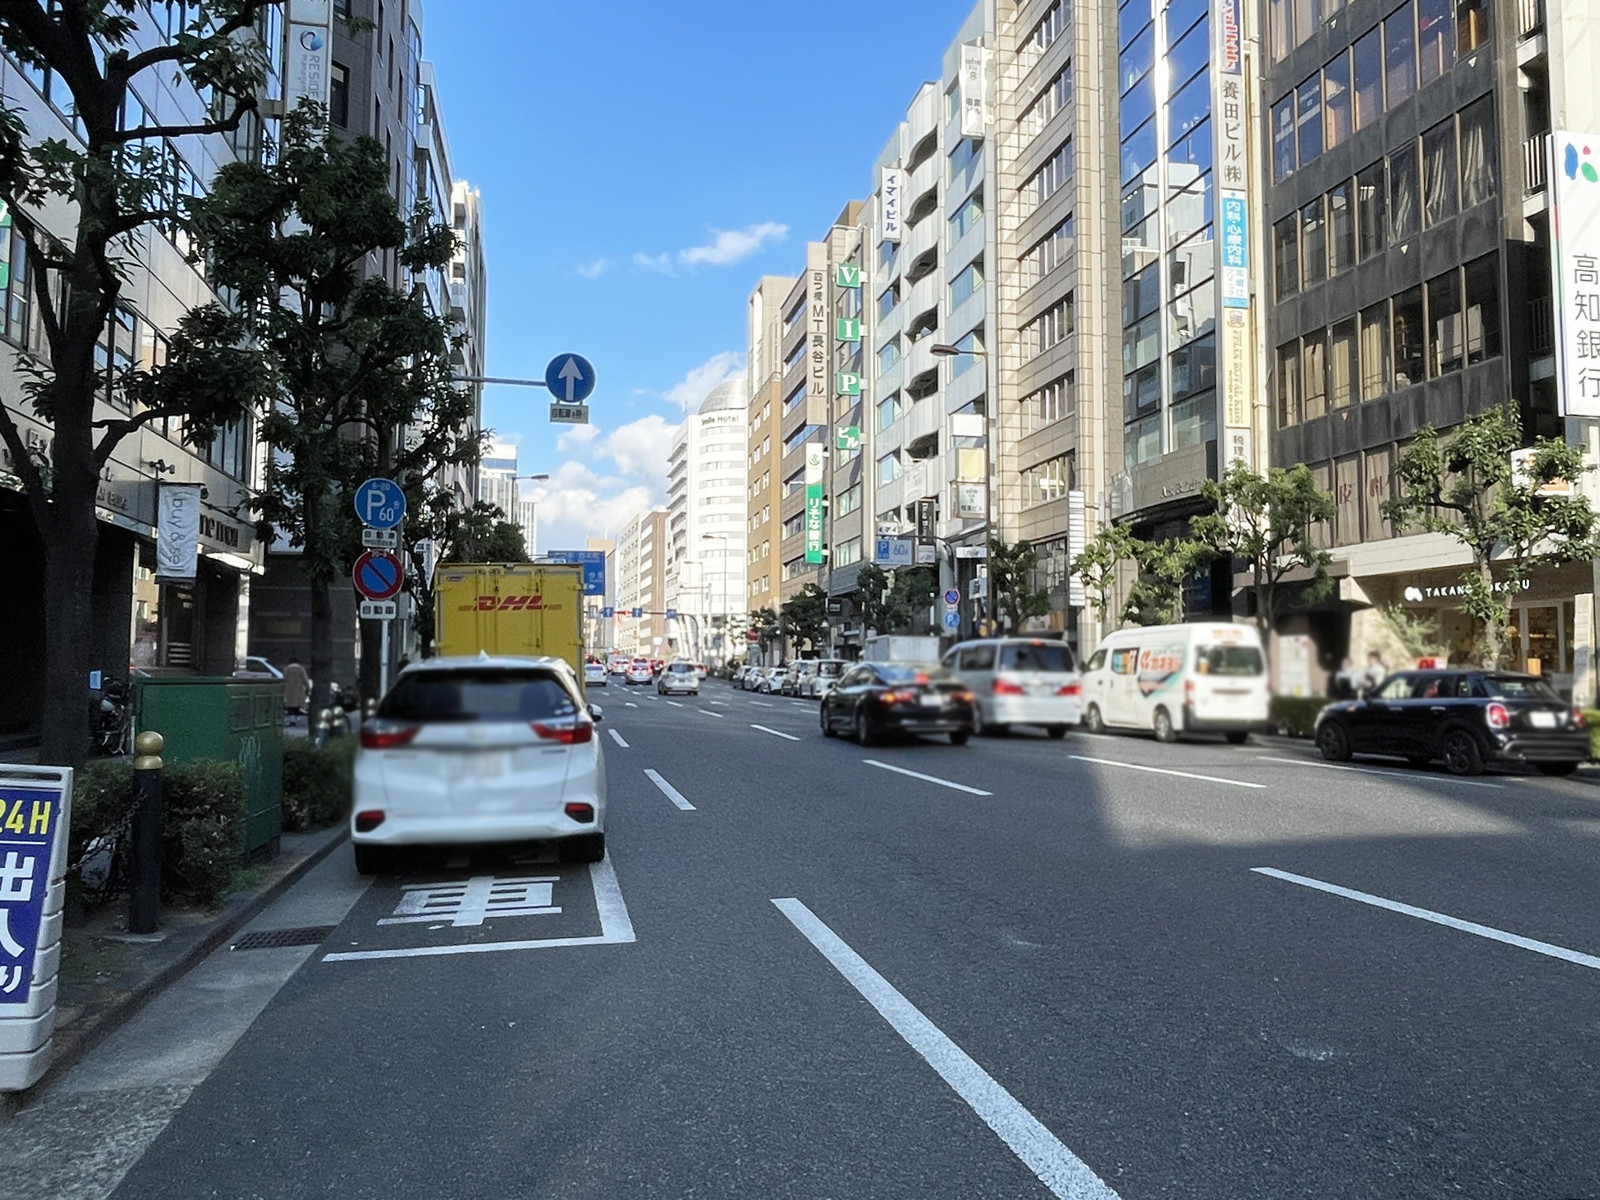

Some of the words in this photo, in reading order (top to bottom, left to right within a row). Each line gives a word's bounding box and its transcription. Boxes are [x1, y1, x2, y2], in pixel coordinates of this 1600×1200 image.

[1225, 33, 1238, 68] kids
[885, 174, 898, 232] イマイビル
[1572, 252, 1600, 399] 高知銀行
[717, 415, 740, 423] Hotel
[366, 489, 387, 521] P
[808, 497, 821, 552] りそな銀行
[473, 595, 547, 611] DHL
[0, 800, 51, 835] 4H
